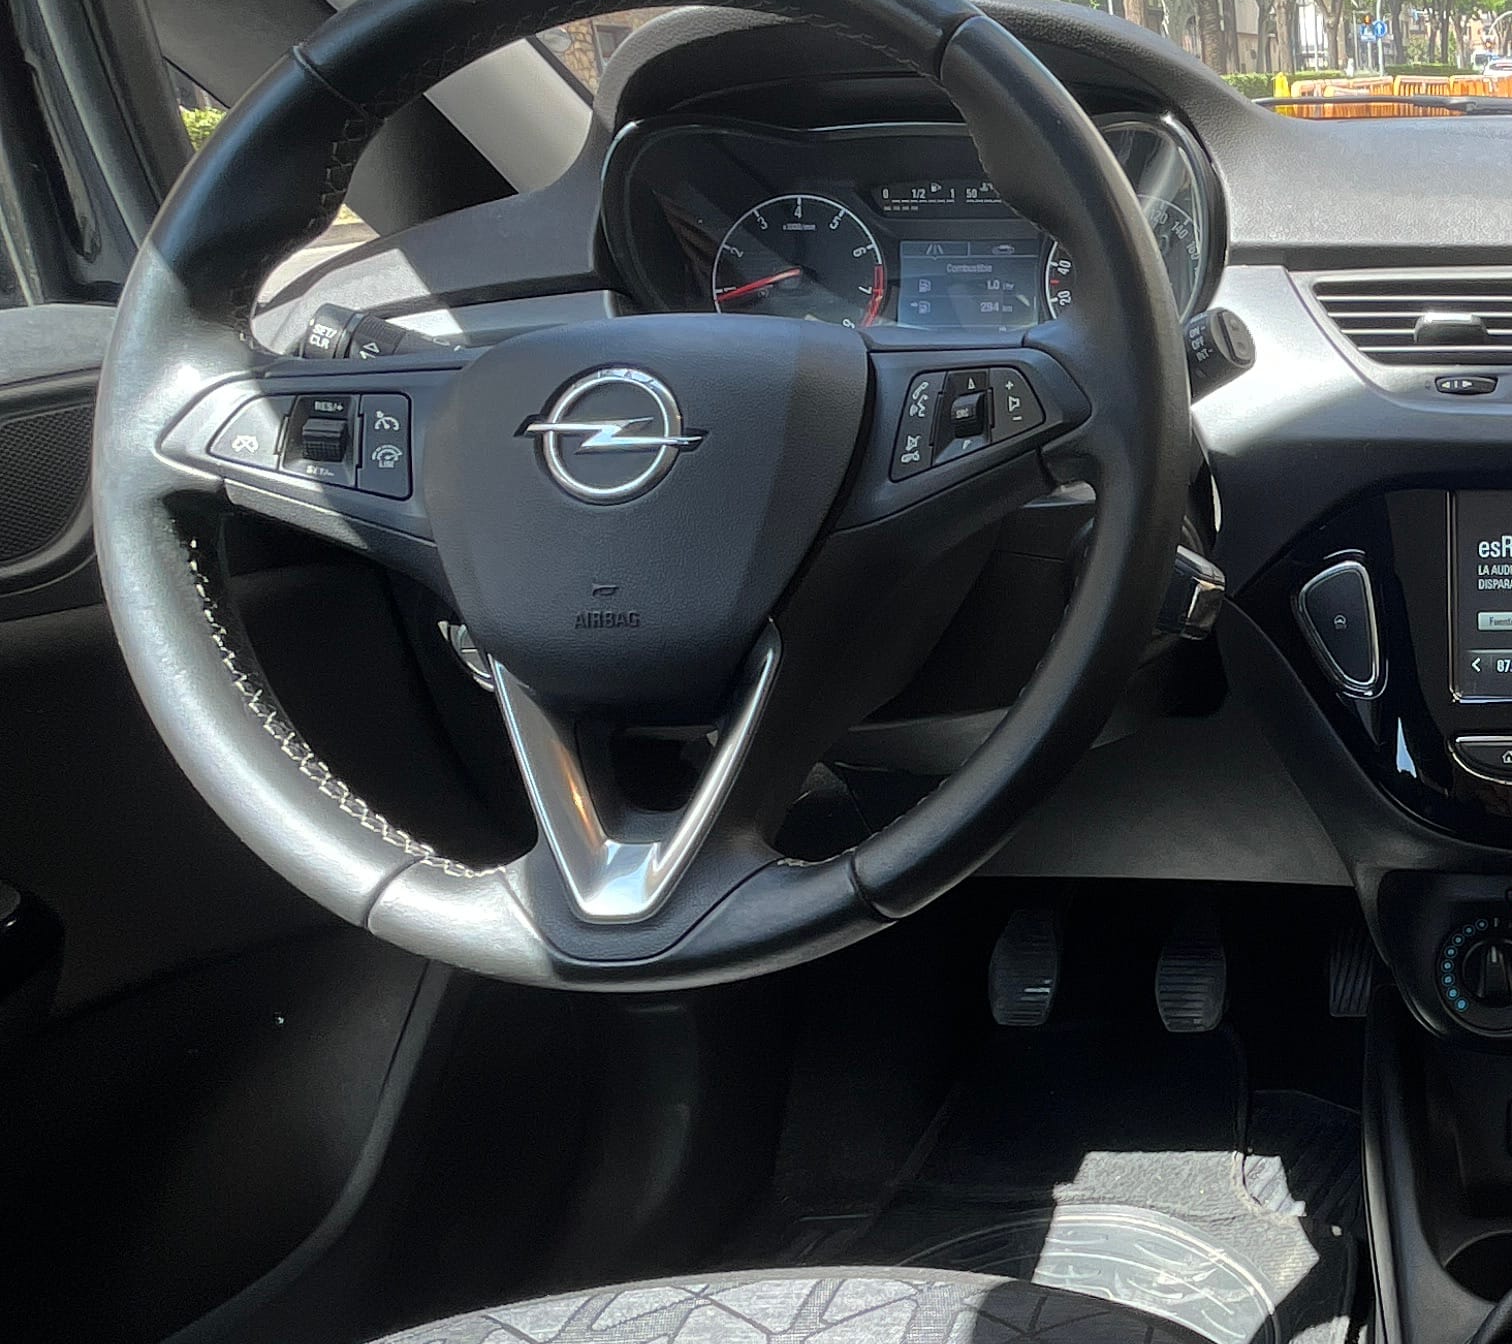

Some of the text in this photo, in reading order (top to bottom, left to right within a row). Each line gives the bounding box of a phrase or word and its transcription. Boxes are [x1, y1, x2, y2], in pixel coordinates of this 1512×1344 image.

[882, 189, 889, 199] 0
[911, 188, 926, 199] 1/2
[966, 188, 978, 199] 50
[794, 206, 803, 218] 4
[758, 216, 769, 230] 3
[829, 216, 841, 230] 5
[1171, 221, 1188, 240] 140
[730, 245, 744, 258] 2
[853, 245, 867, 258] 6
[1057, 260, 1072, 276] 40
[858, 286, 872, 295] 7
[1057, 289, 1072, 306] 20
[309, 334, 330, 350] CLR
[1478, 564, 1489, 576] LA
[575, 612, 641, 629] AIRBAG
